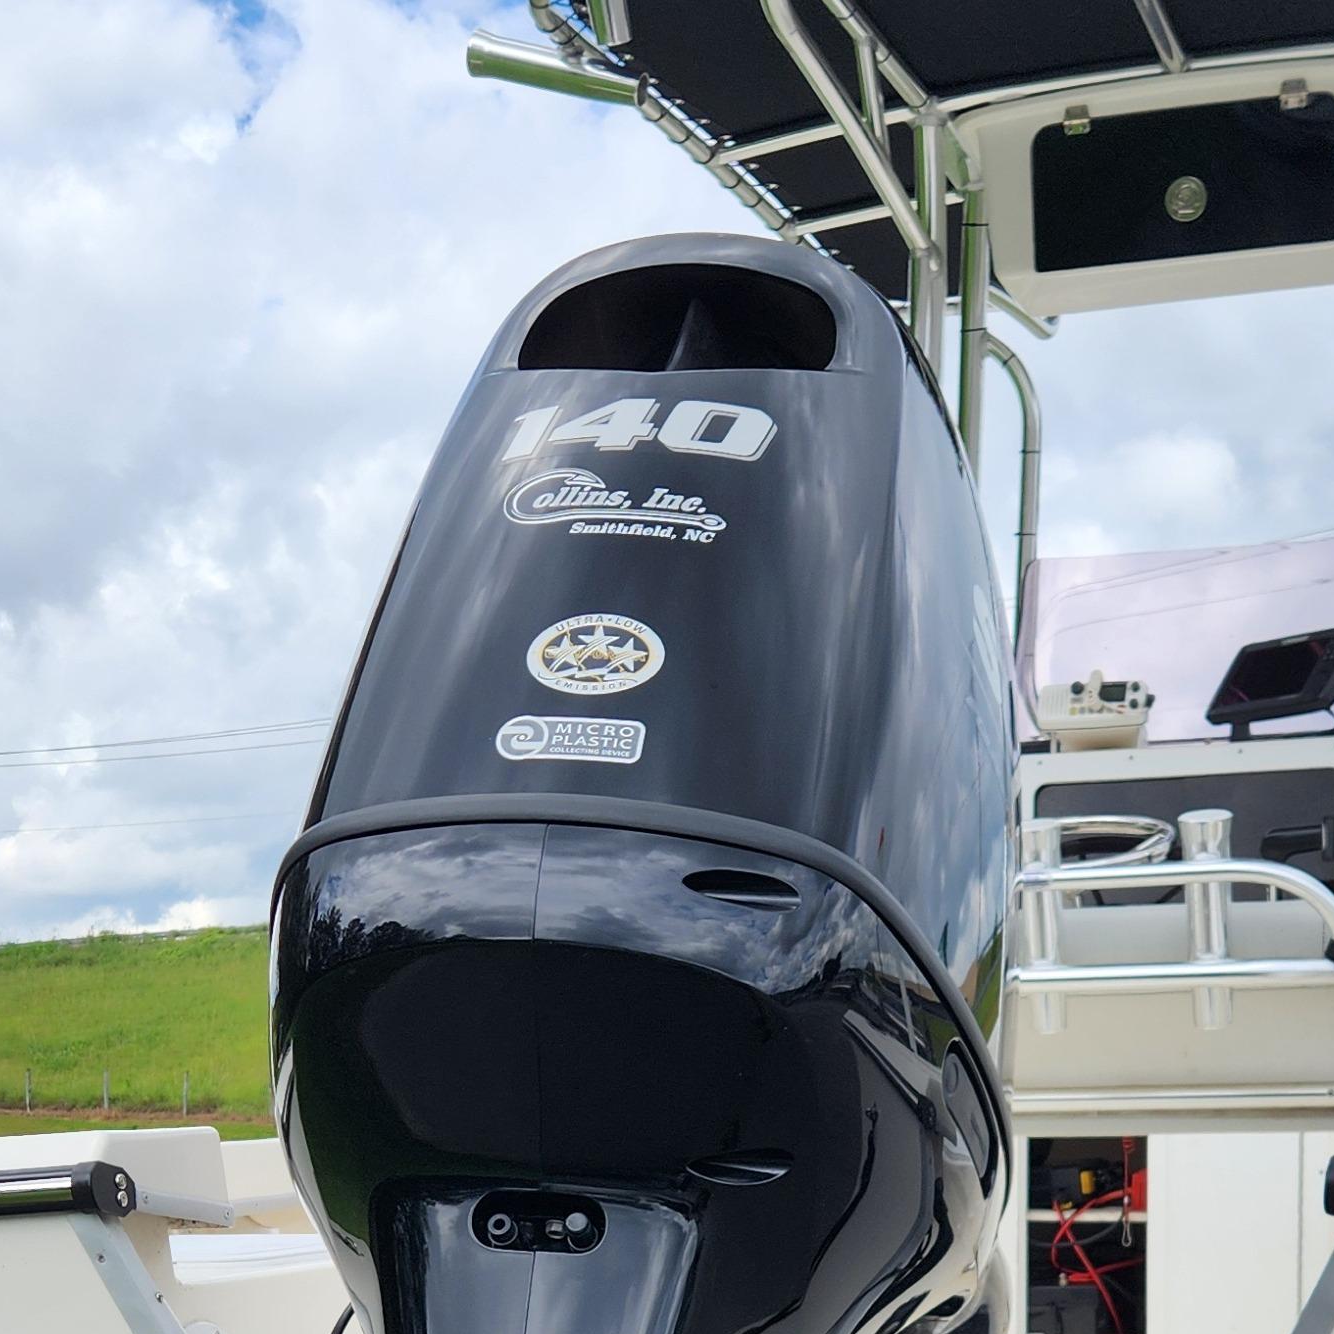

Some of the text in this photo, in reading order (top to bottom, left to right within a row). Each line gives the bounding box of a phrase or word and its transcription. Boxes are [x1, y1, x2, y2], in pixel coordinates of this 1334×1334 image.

[502, 398, 778, 463] 140
[504, 467, 707, 523] Collins, Inc.
[568, 521, 716, 544] Smithfield, NC
[555, 615, 648, 634] ULTRA LOW
[555, 680, 627, 691] EMISSION
[555, 723, 635, 738] MICRO
[551, 735, 633, 750] PLASTIC
[549, 746, 631, 758] COLLECTING DEVICE
